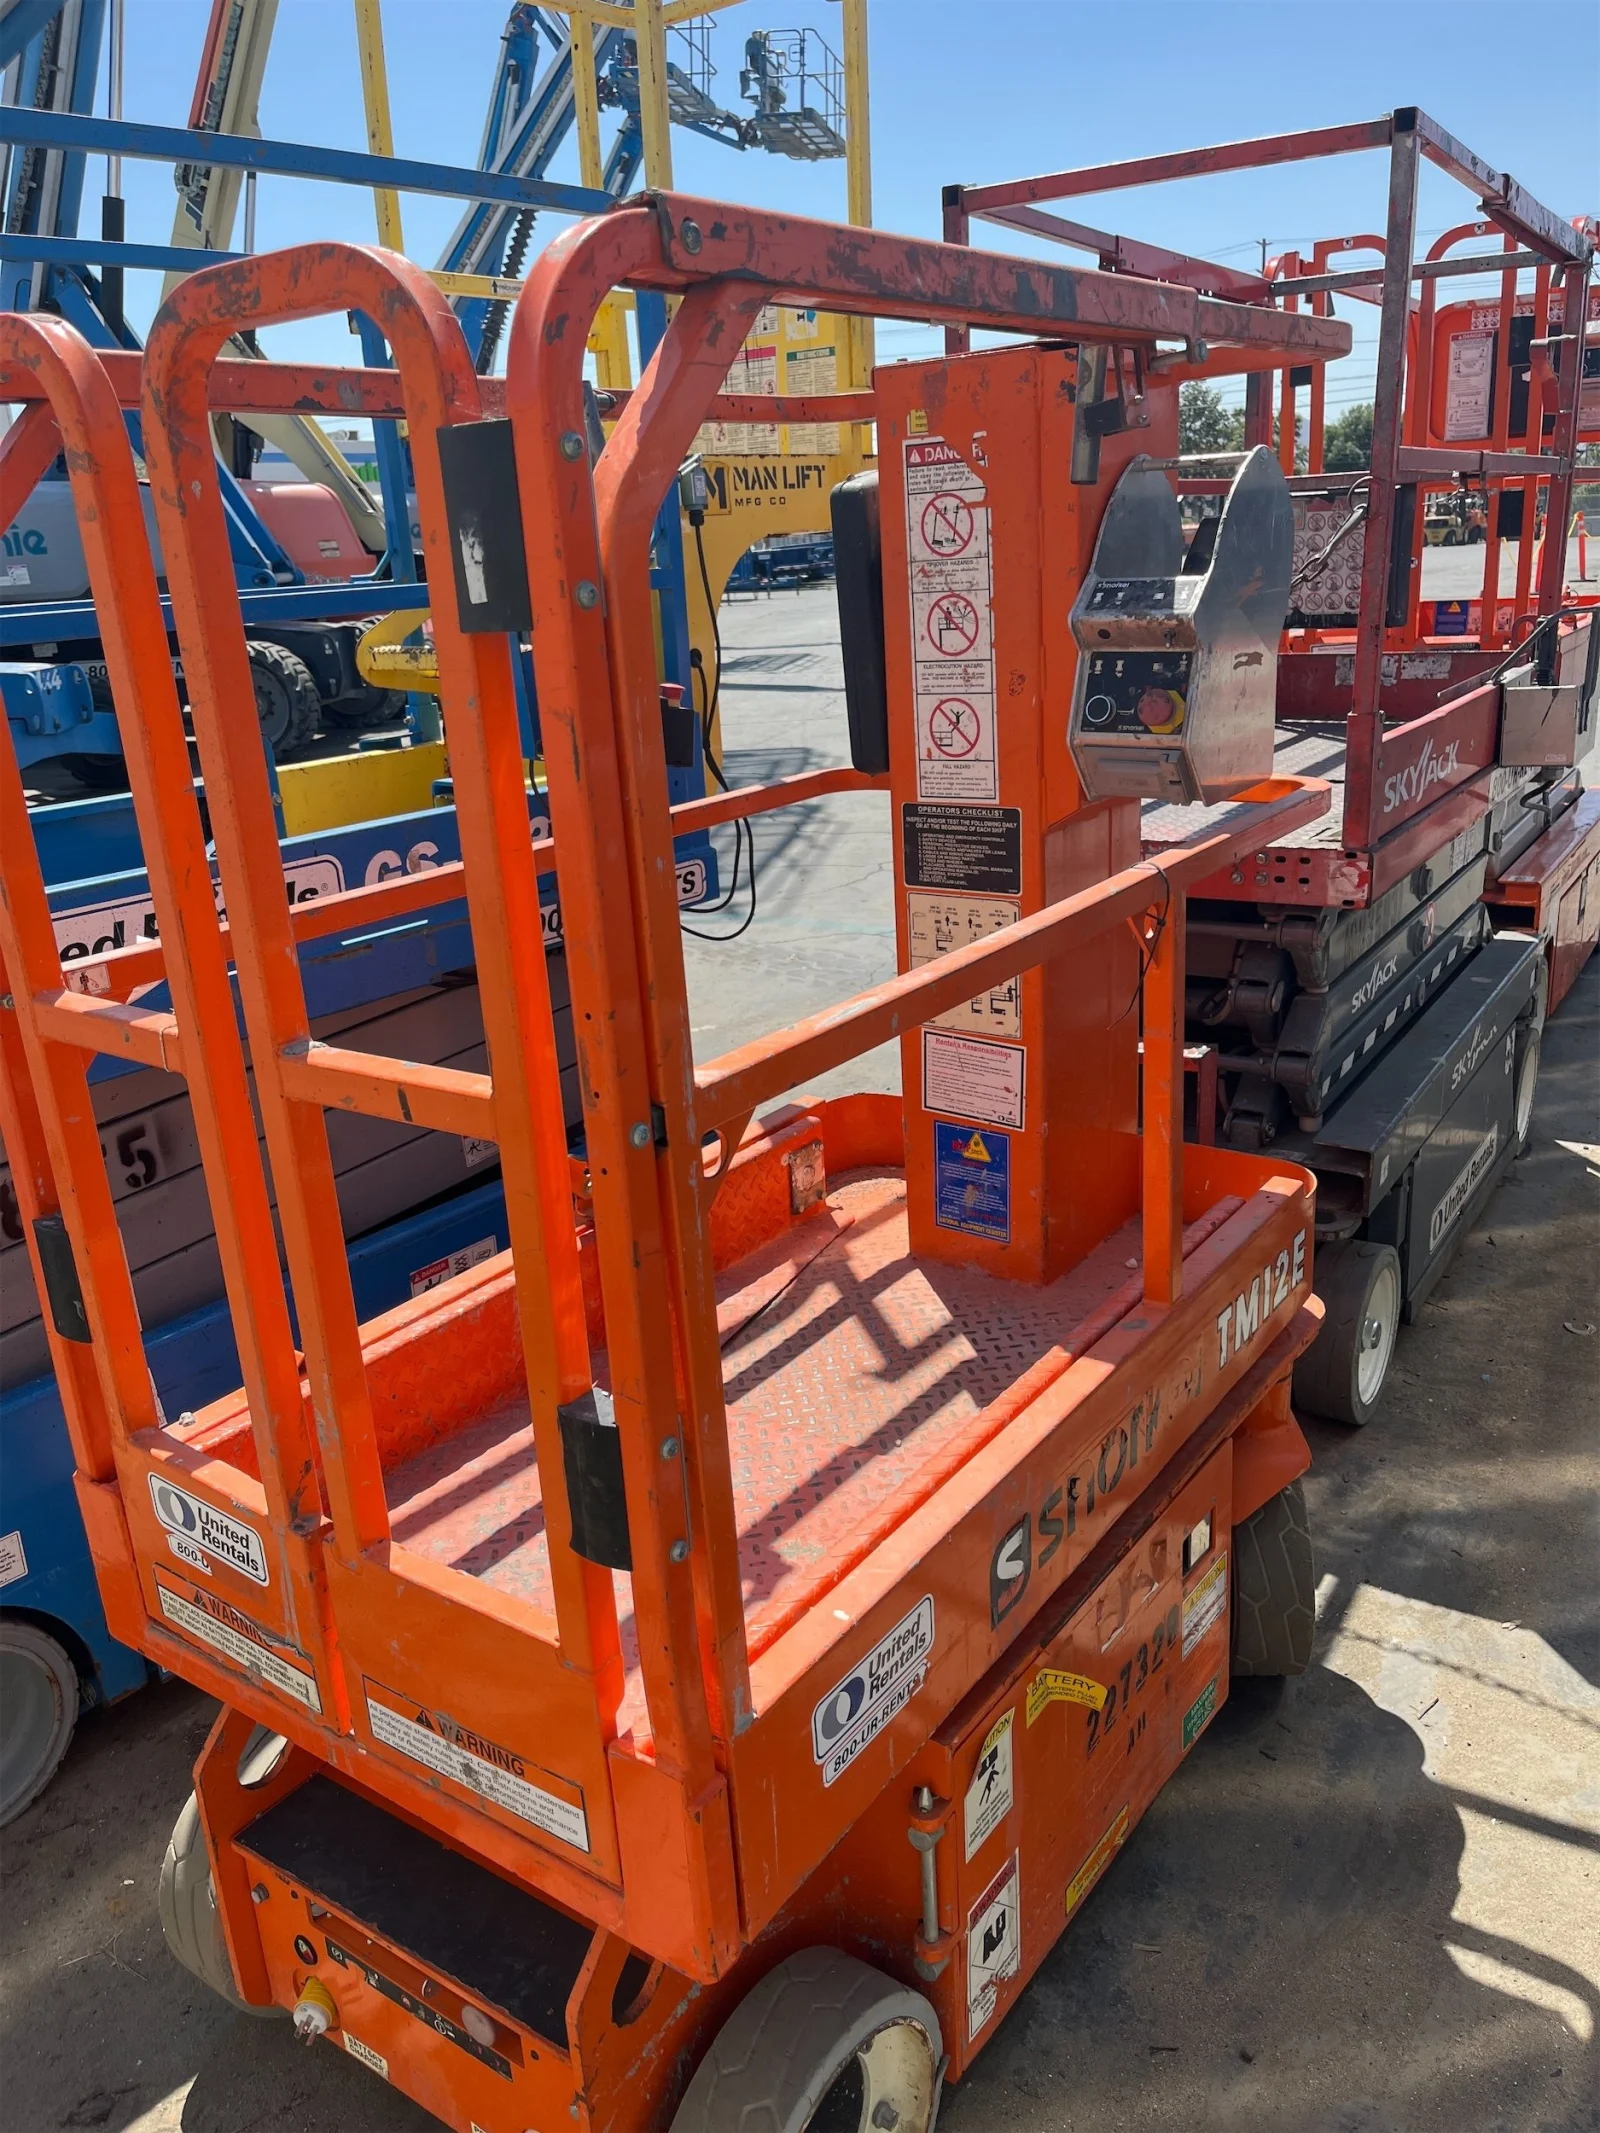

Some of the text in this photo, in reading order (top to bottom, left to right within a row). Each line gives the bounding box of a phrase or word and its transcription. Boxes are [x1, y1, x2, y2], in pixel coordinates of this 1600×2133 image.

[733, 466, 777, 491] MAN
[783, 465, 826, 489] LIFT
[735, 496, 786, 507] MFG CO
[1383, 736, 1459, 813] SKYJACK
[917, 806, 1003, 816] OPERATORS CHECKLIST
[1351, 955, 1398, 1014] SKYJACK
[1444, 1169, 1469, 1224] United
[421, 1263, 447, 1278] DANGER
[1217, 1229, 1307, 1371] TM12E
[198, 1506, 250, 1550] United
[201, 1525, 259, 1572] Rentals
[868, 1611, 923, 1675] United
[869, 1632, 927, 1701] Rentals
[1032, 1673, 1095, 1697] BATTERY
[378, 1709, 412, 1731] personnel
[534, 1790, 580, 1820] understand
[436, 1717, 525, 1778] WARNING
[348, 2036, 383, 2063] BATTERY
[349, 2044, 386, 2073] CHARGER
